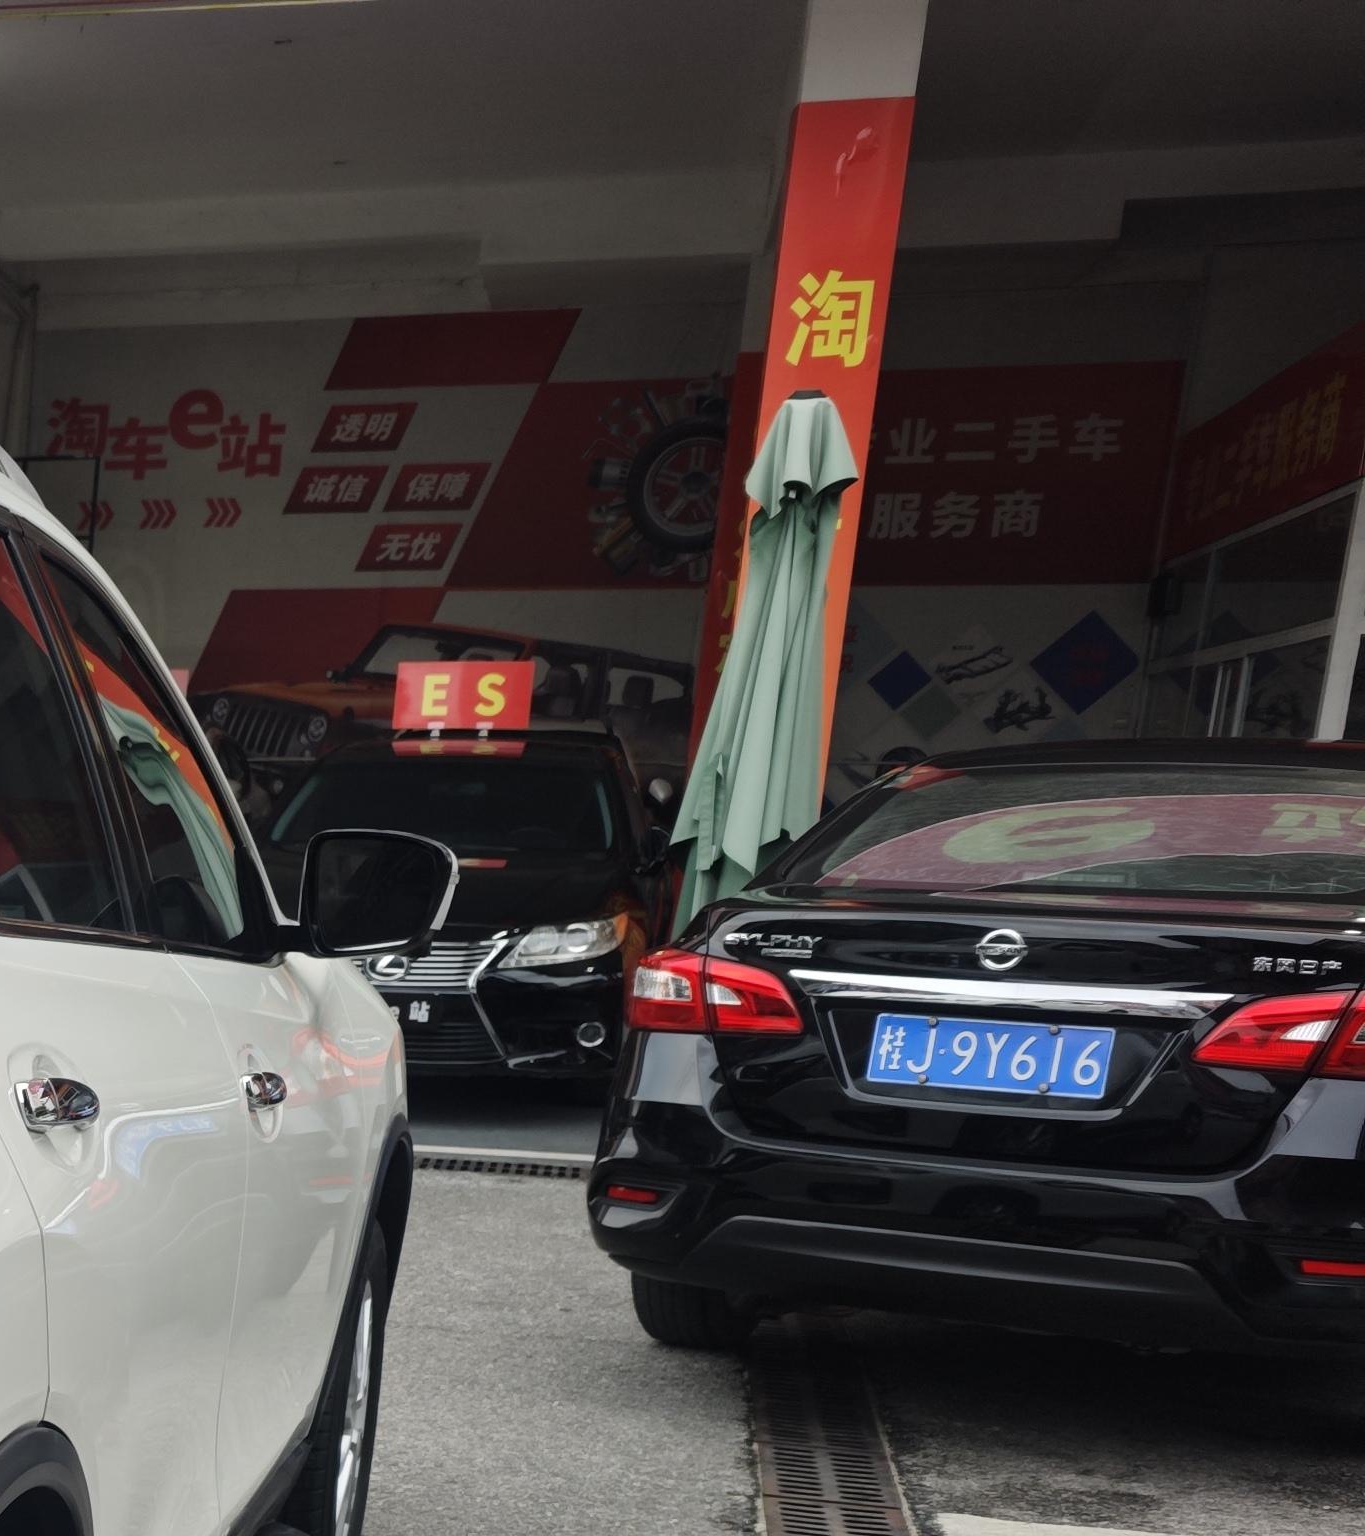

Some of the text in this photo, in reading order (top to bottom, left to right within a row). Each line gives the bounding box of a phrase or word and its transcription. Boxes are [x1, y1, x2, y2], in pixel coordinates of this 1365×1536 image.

[331, 411, 397, 443] 透明
[871, 411, 1126, 465] 业二手车
[304, 474, 368, 504] 诚信
[405, 472, 470, 503] 保障
[867, 490, 1045, 540] 服务商
[376, 532, 441, 562] 无忧
[1252, 955, 1343, 976] 东风日产
